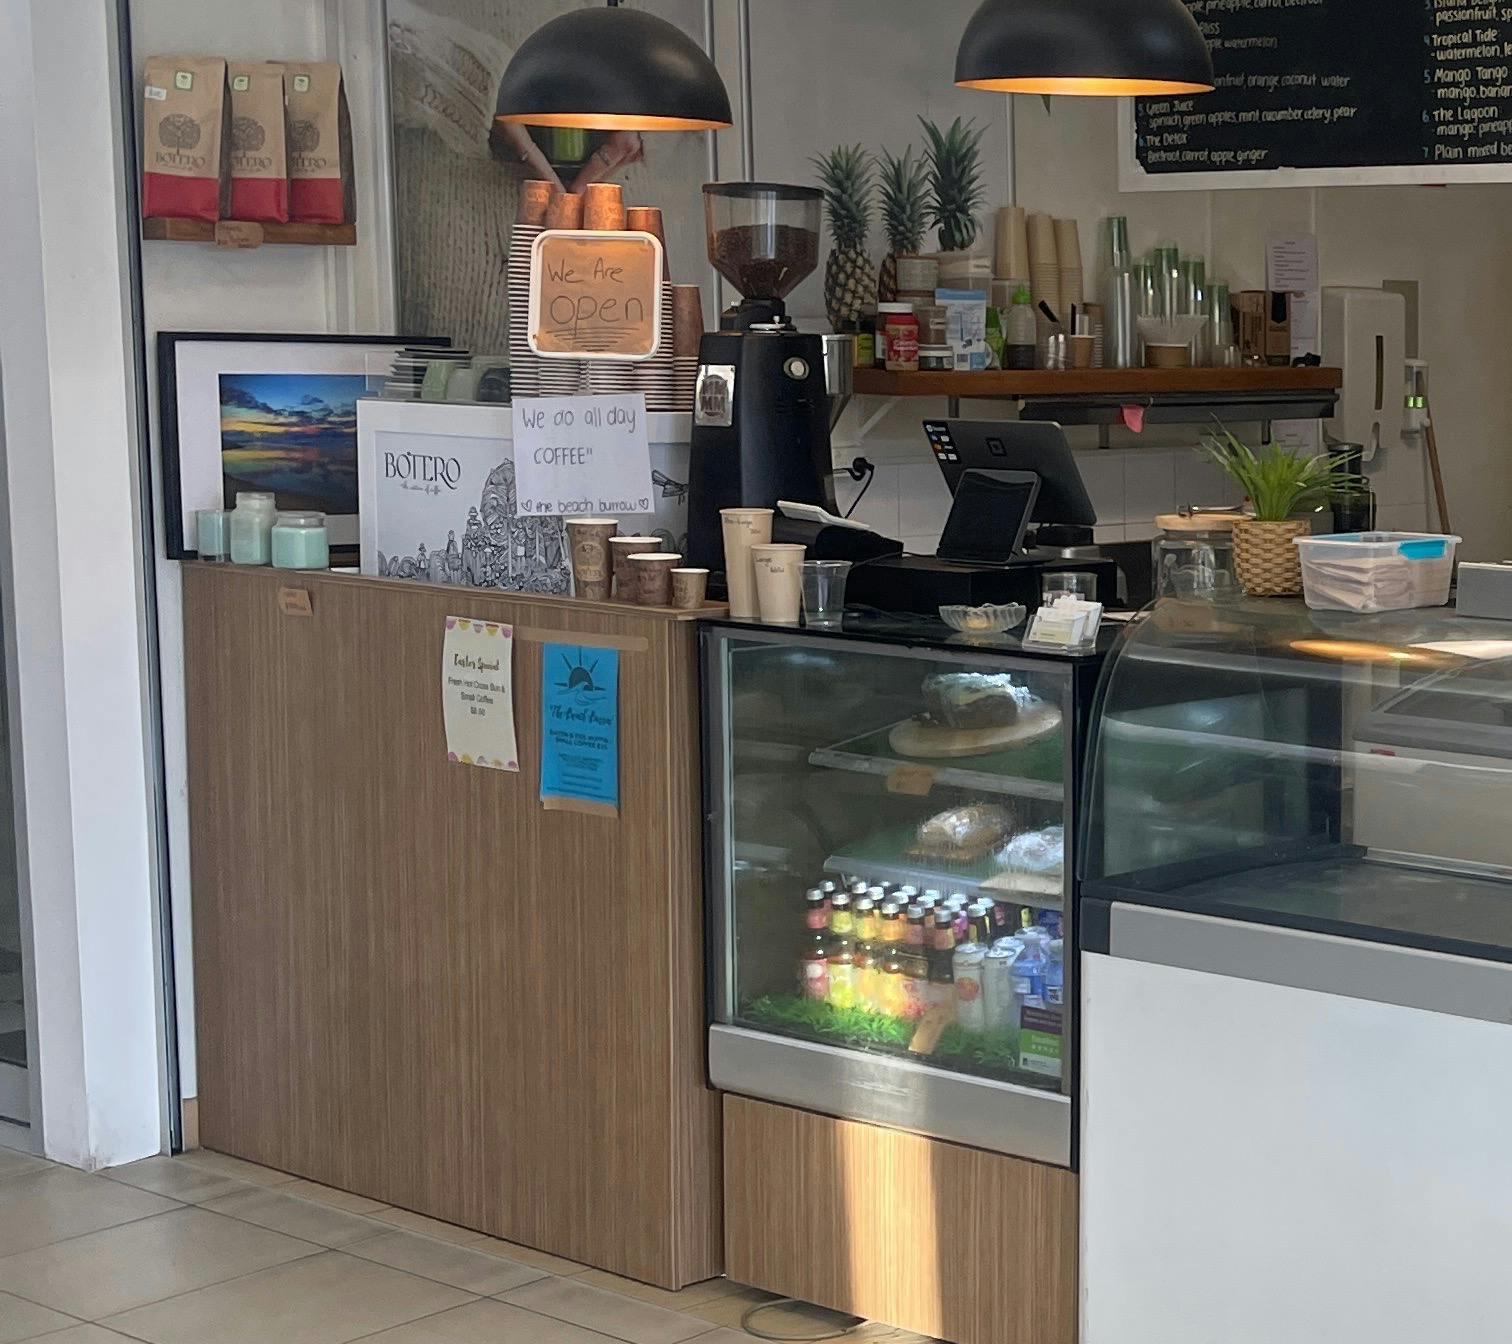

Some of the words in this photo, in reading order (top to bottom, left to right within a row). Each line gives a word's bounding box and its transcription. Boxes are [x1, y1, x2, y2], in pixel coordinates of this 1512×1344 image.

[1432, 29, 1473, 47] Tropical
[1475, 28, 1498, 42] Tide
[1434, 68, 1472, 87] Mango
[1475, 66, 1508, 85] Tango
[1432, 107, 1454, 122] The
[1457, 106, 1499, 126] Lagoon
[1435, 143, 1463, 160] Plain
[547, 259, 583, 284] We
[593, 257, 625, 284] Are
[521, 407, 545, 430] We
[553, 408, 574, 427] do
[584, 406, 601, 428] all
[606, 406, 636, 434] day
[384, 451, 461, 490] BOTERO
[557, 498, 593, 513] beach
[598, 500, 637, 513] burrow
